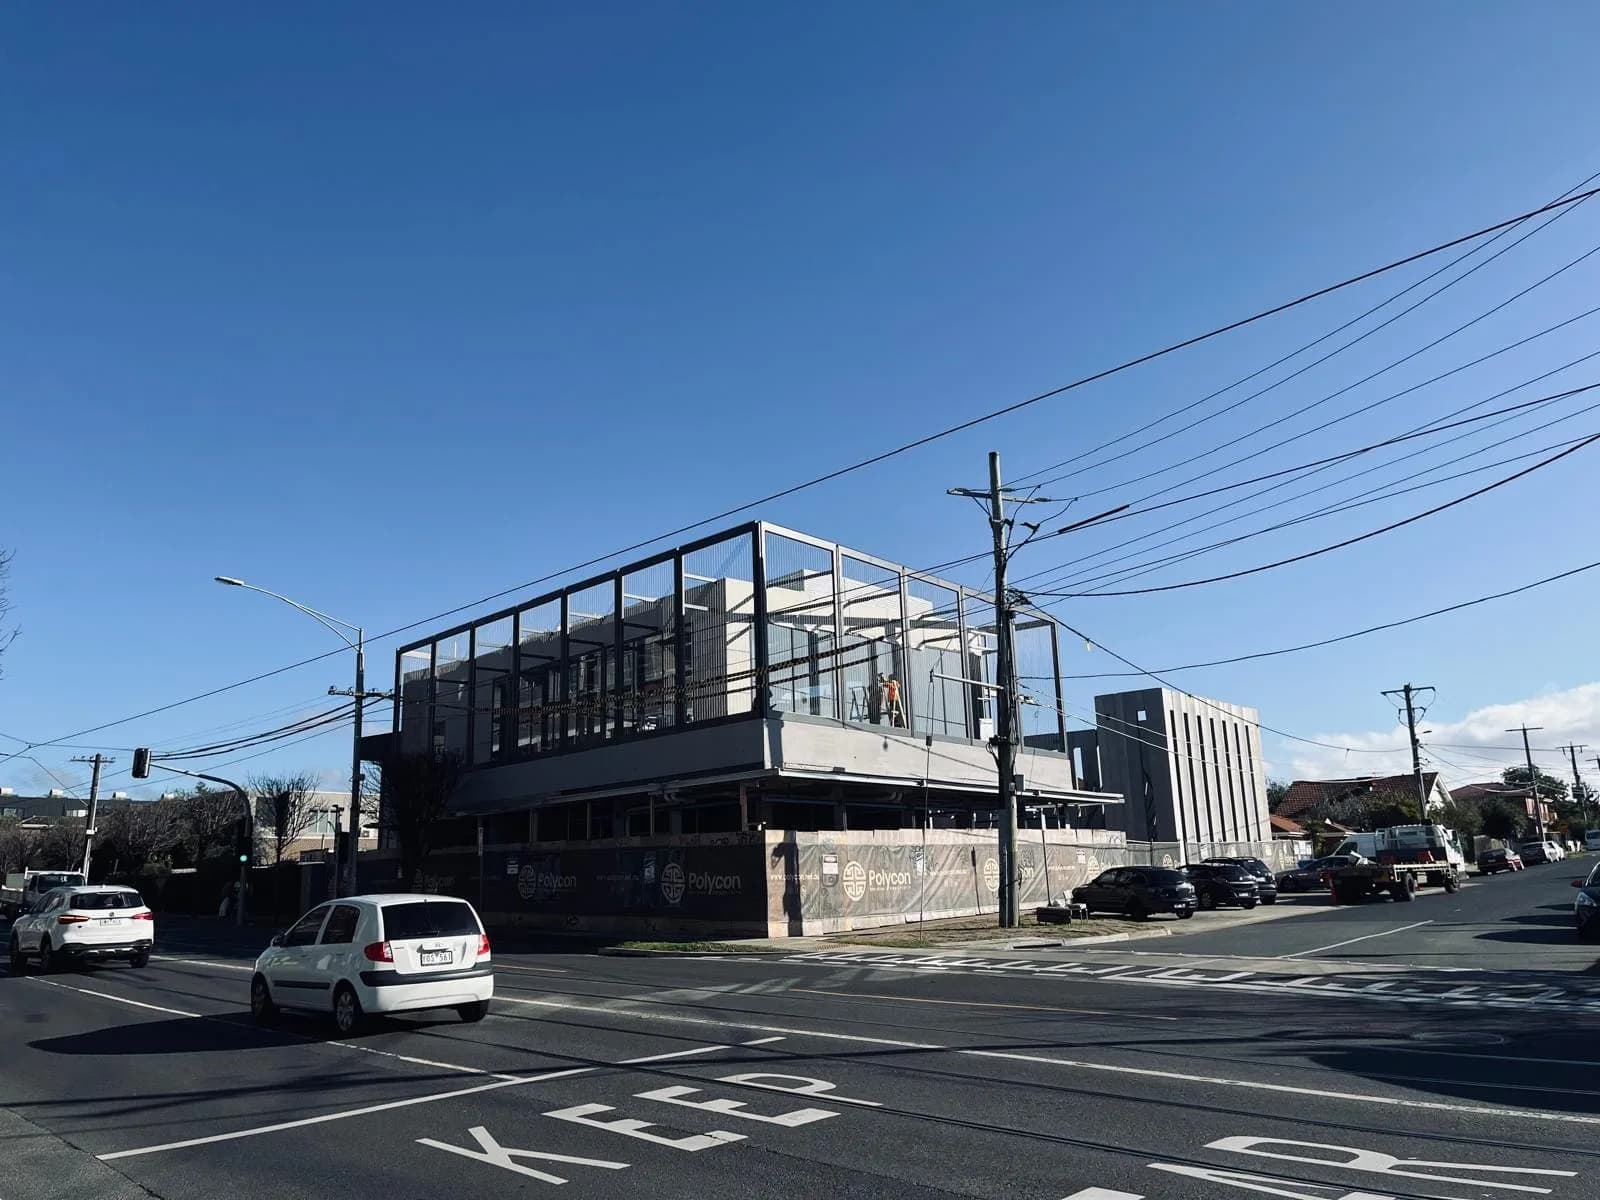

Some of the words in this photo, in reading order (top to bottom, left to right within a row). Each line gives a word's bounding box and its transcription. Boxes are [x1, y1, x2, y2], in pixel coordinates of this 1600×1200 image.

[538, 872, 577, 892] Polycon
[688, 872, 742, 895] Polycon
[869, 868, 912, 890] Polycon
[414, 1072, 884, 1185] KEEP
